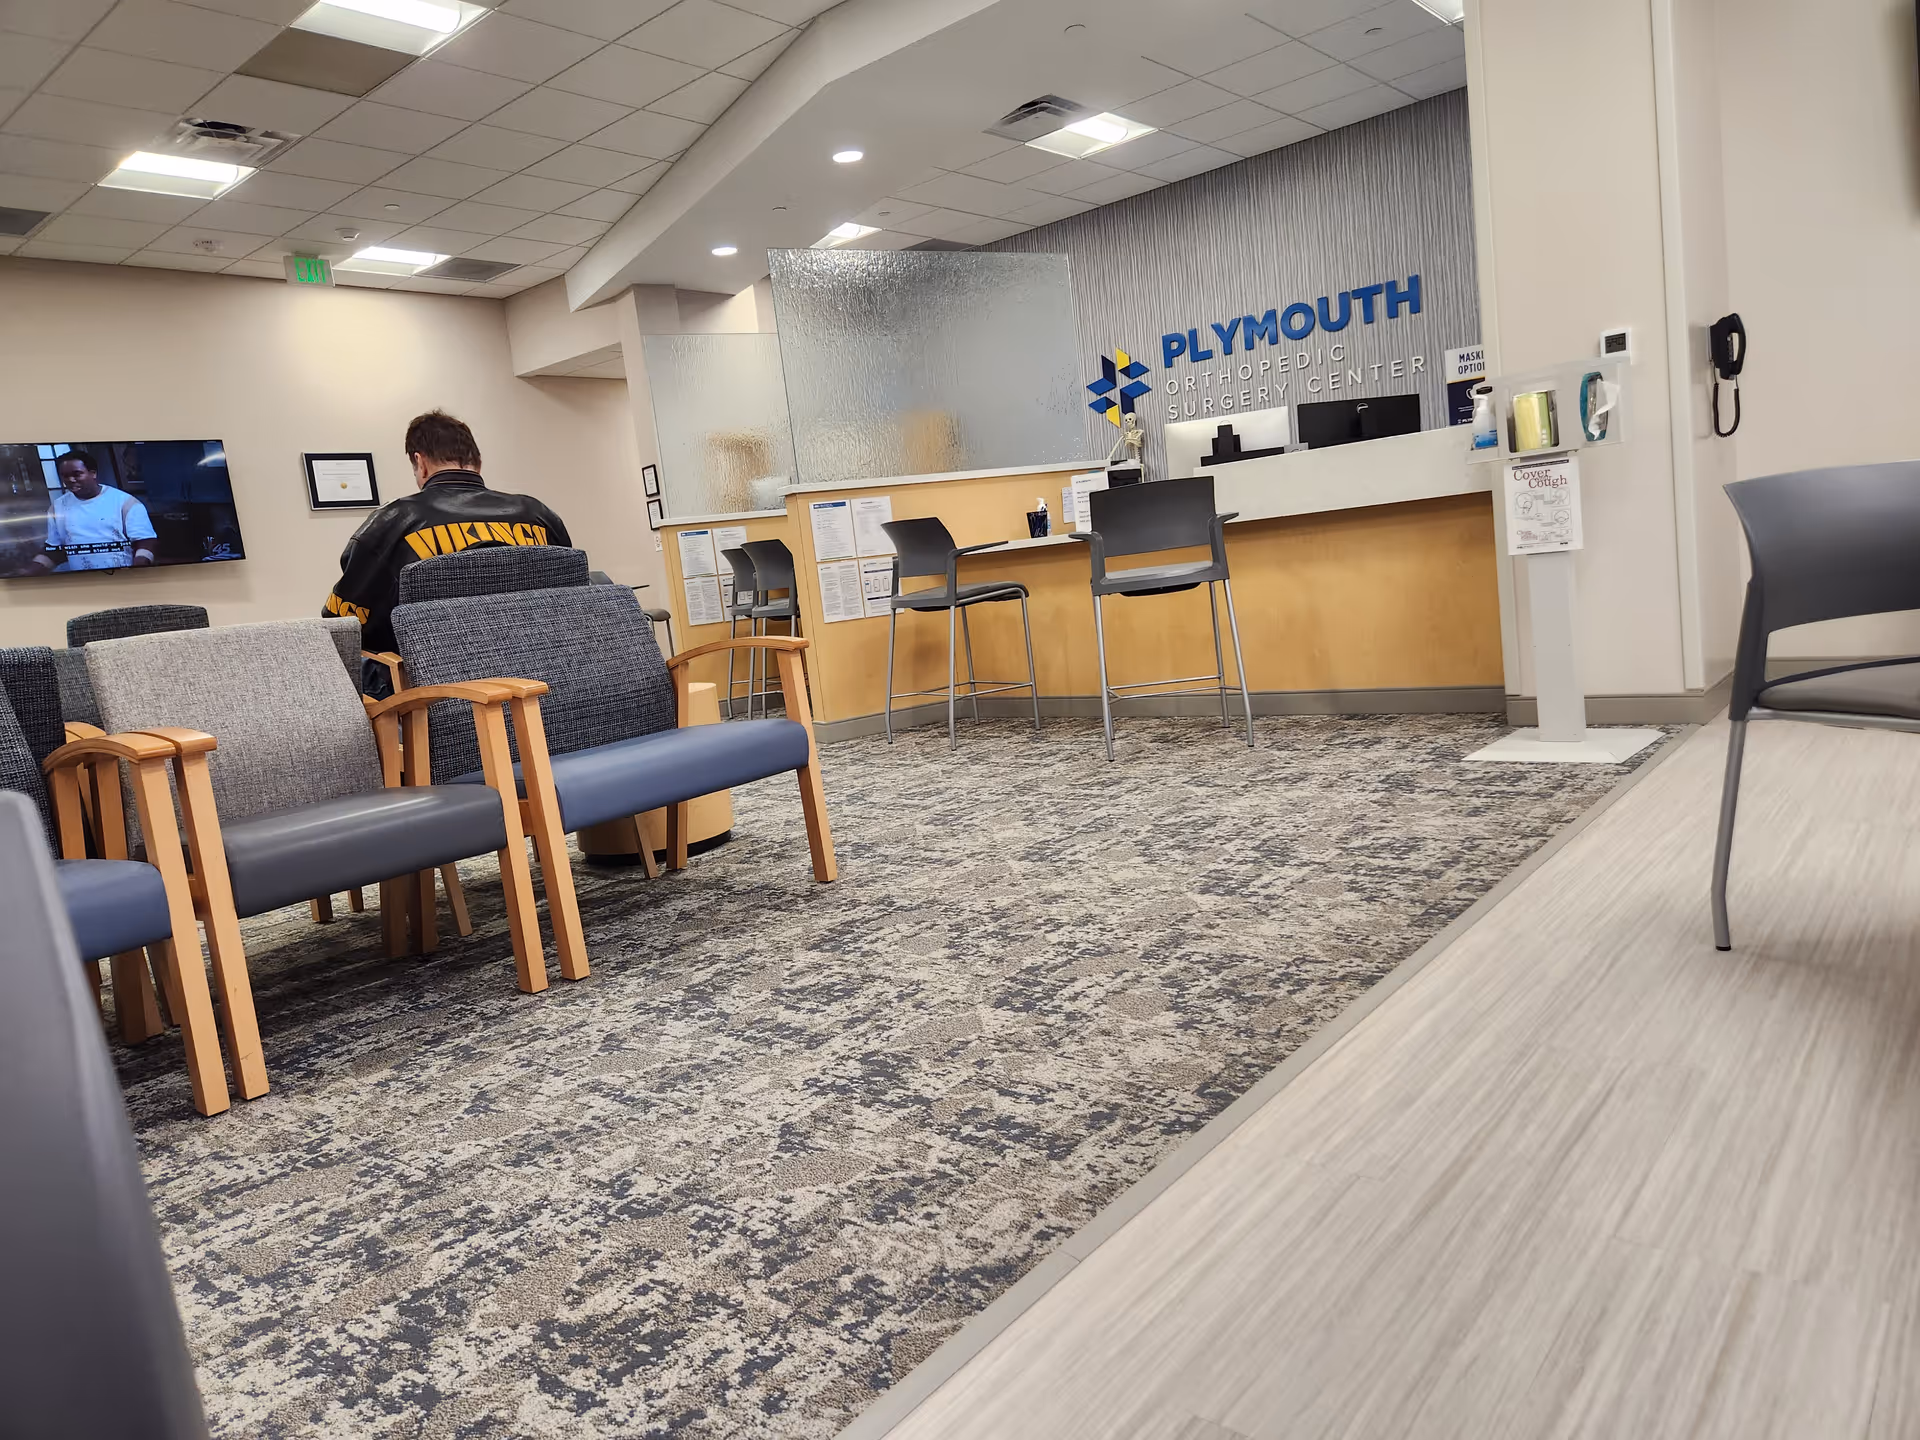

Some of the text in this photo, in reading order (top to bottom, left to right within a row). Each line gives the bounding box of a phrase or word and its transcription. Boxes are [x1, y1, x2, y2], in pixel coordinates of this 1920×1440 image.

[294, 257, 326, 283] EXIT
[1161, 274, 1421, 368] PLYMOUTH
[1459, 350, 1484, 363] MASKI
[1166, 344, 1345, 395] ORTHOPEDIC
[1168, 356, 1425, 420] SURGERY CENTER
[1513, 469, 1551, 481] Cover
[1528, 475, 1568, 489] Cough
[212, 543, 230, 554] 45
